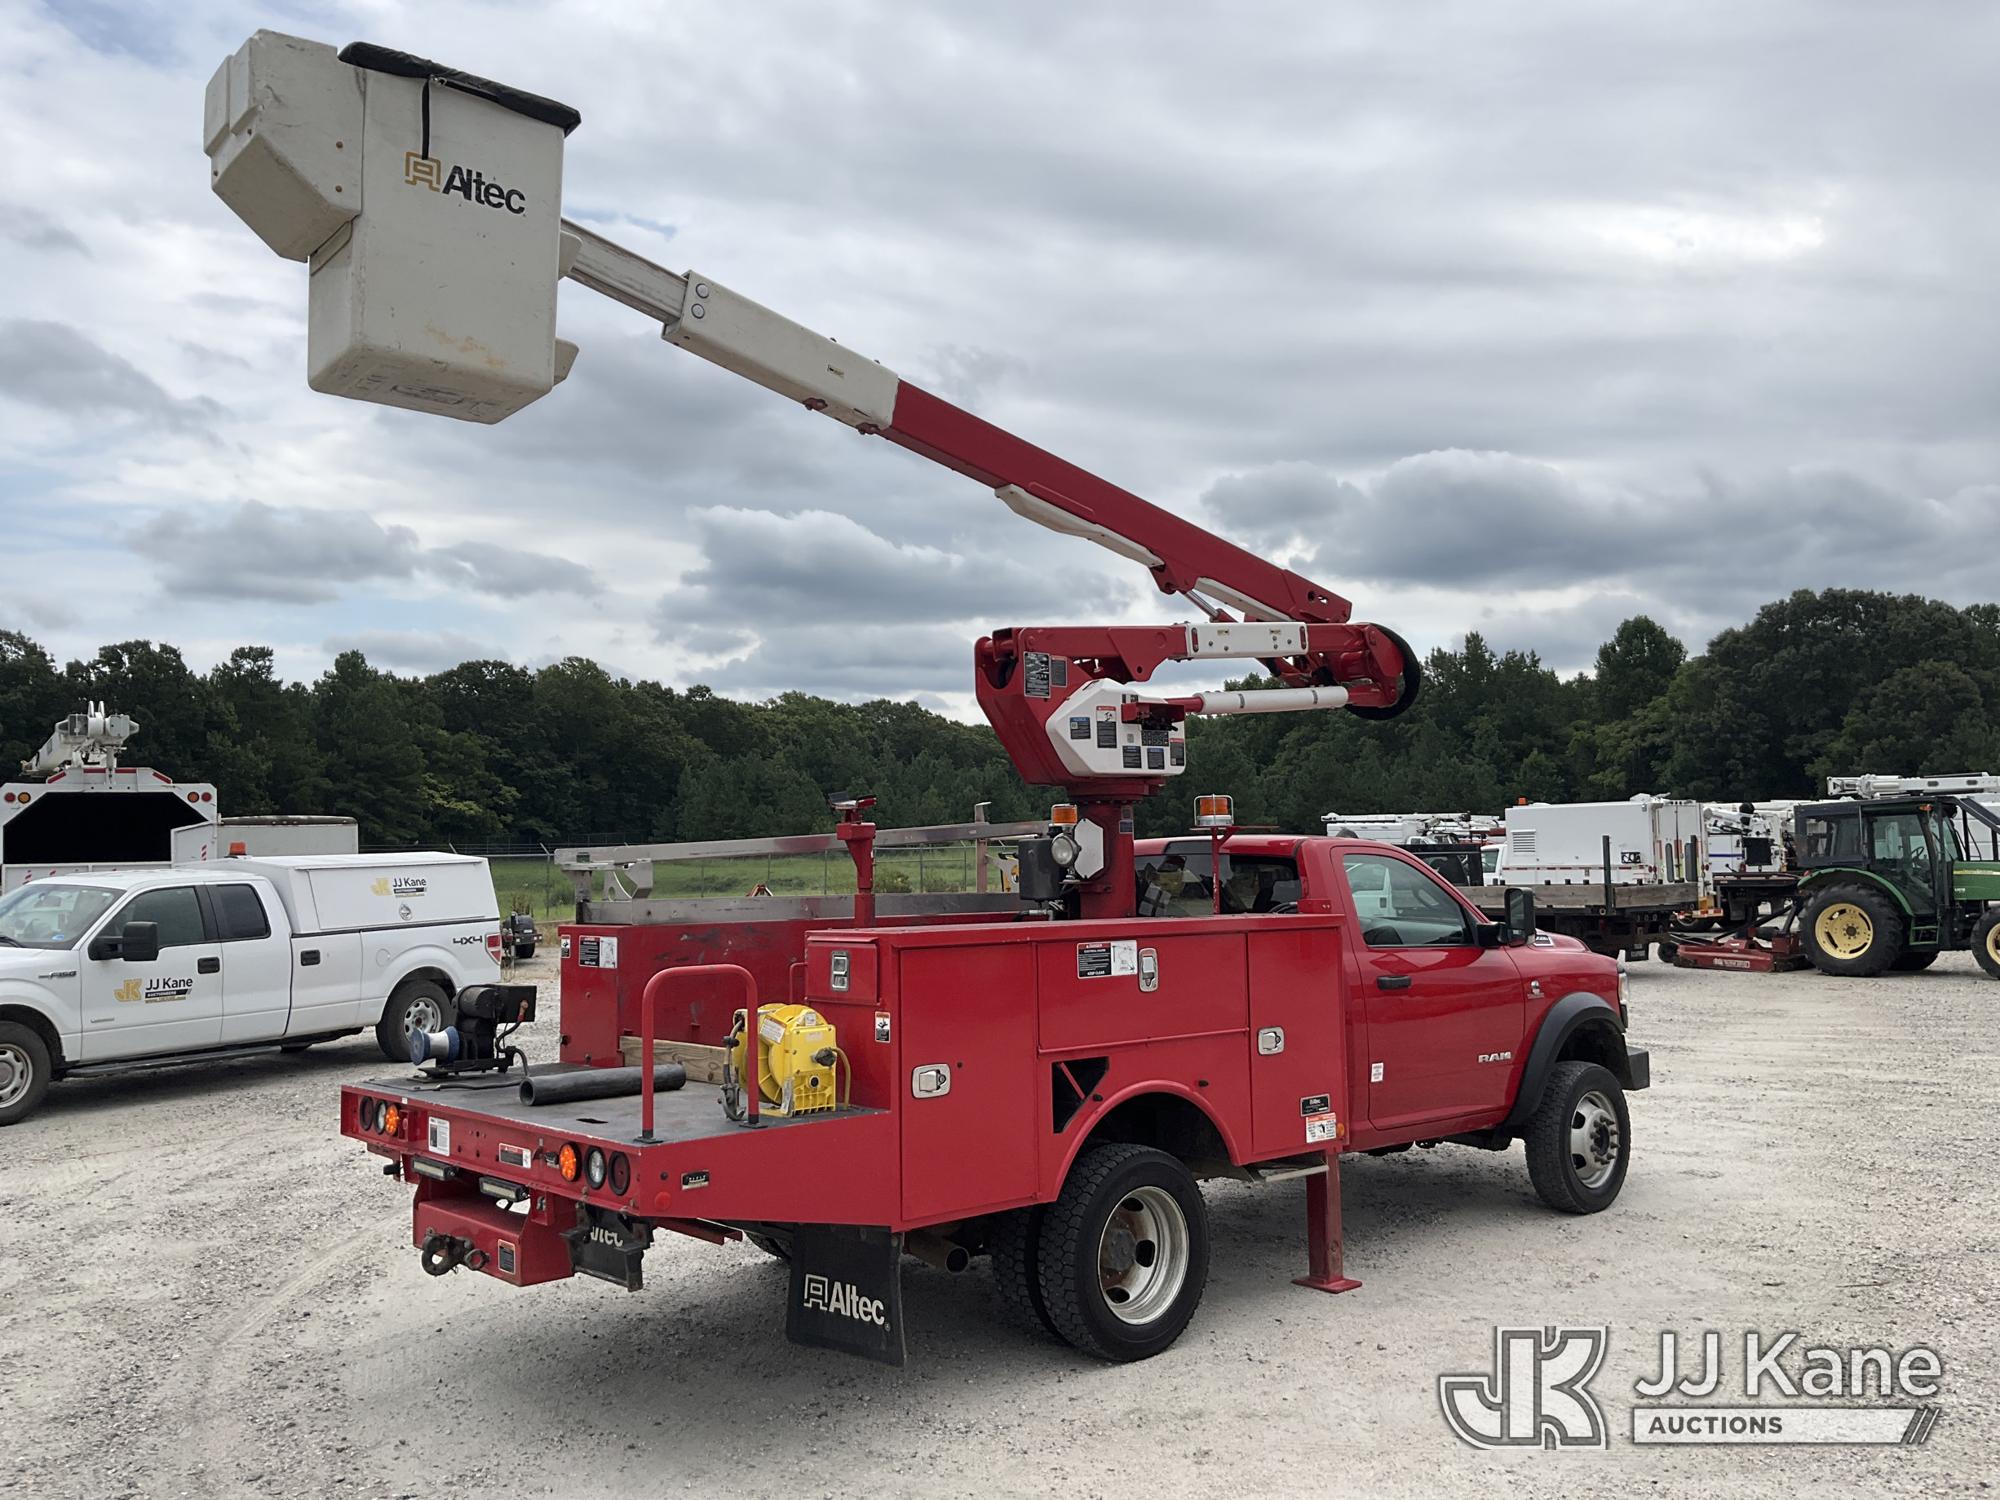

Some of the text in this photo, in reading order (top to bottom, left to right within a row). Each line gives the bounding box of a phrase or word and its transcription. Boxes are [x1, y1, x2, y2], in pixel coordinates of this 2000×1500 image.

[442, 165, 526, 214] Altec
[393, 878, 426, 887] JJ Kane
[146, 978, 193, 990] JJ Kane
[1478, 1052, 1511, 1063] RAM
[828, 1281, 885, 1325] Altec
